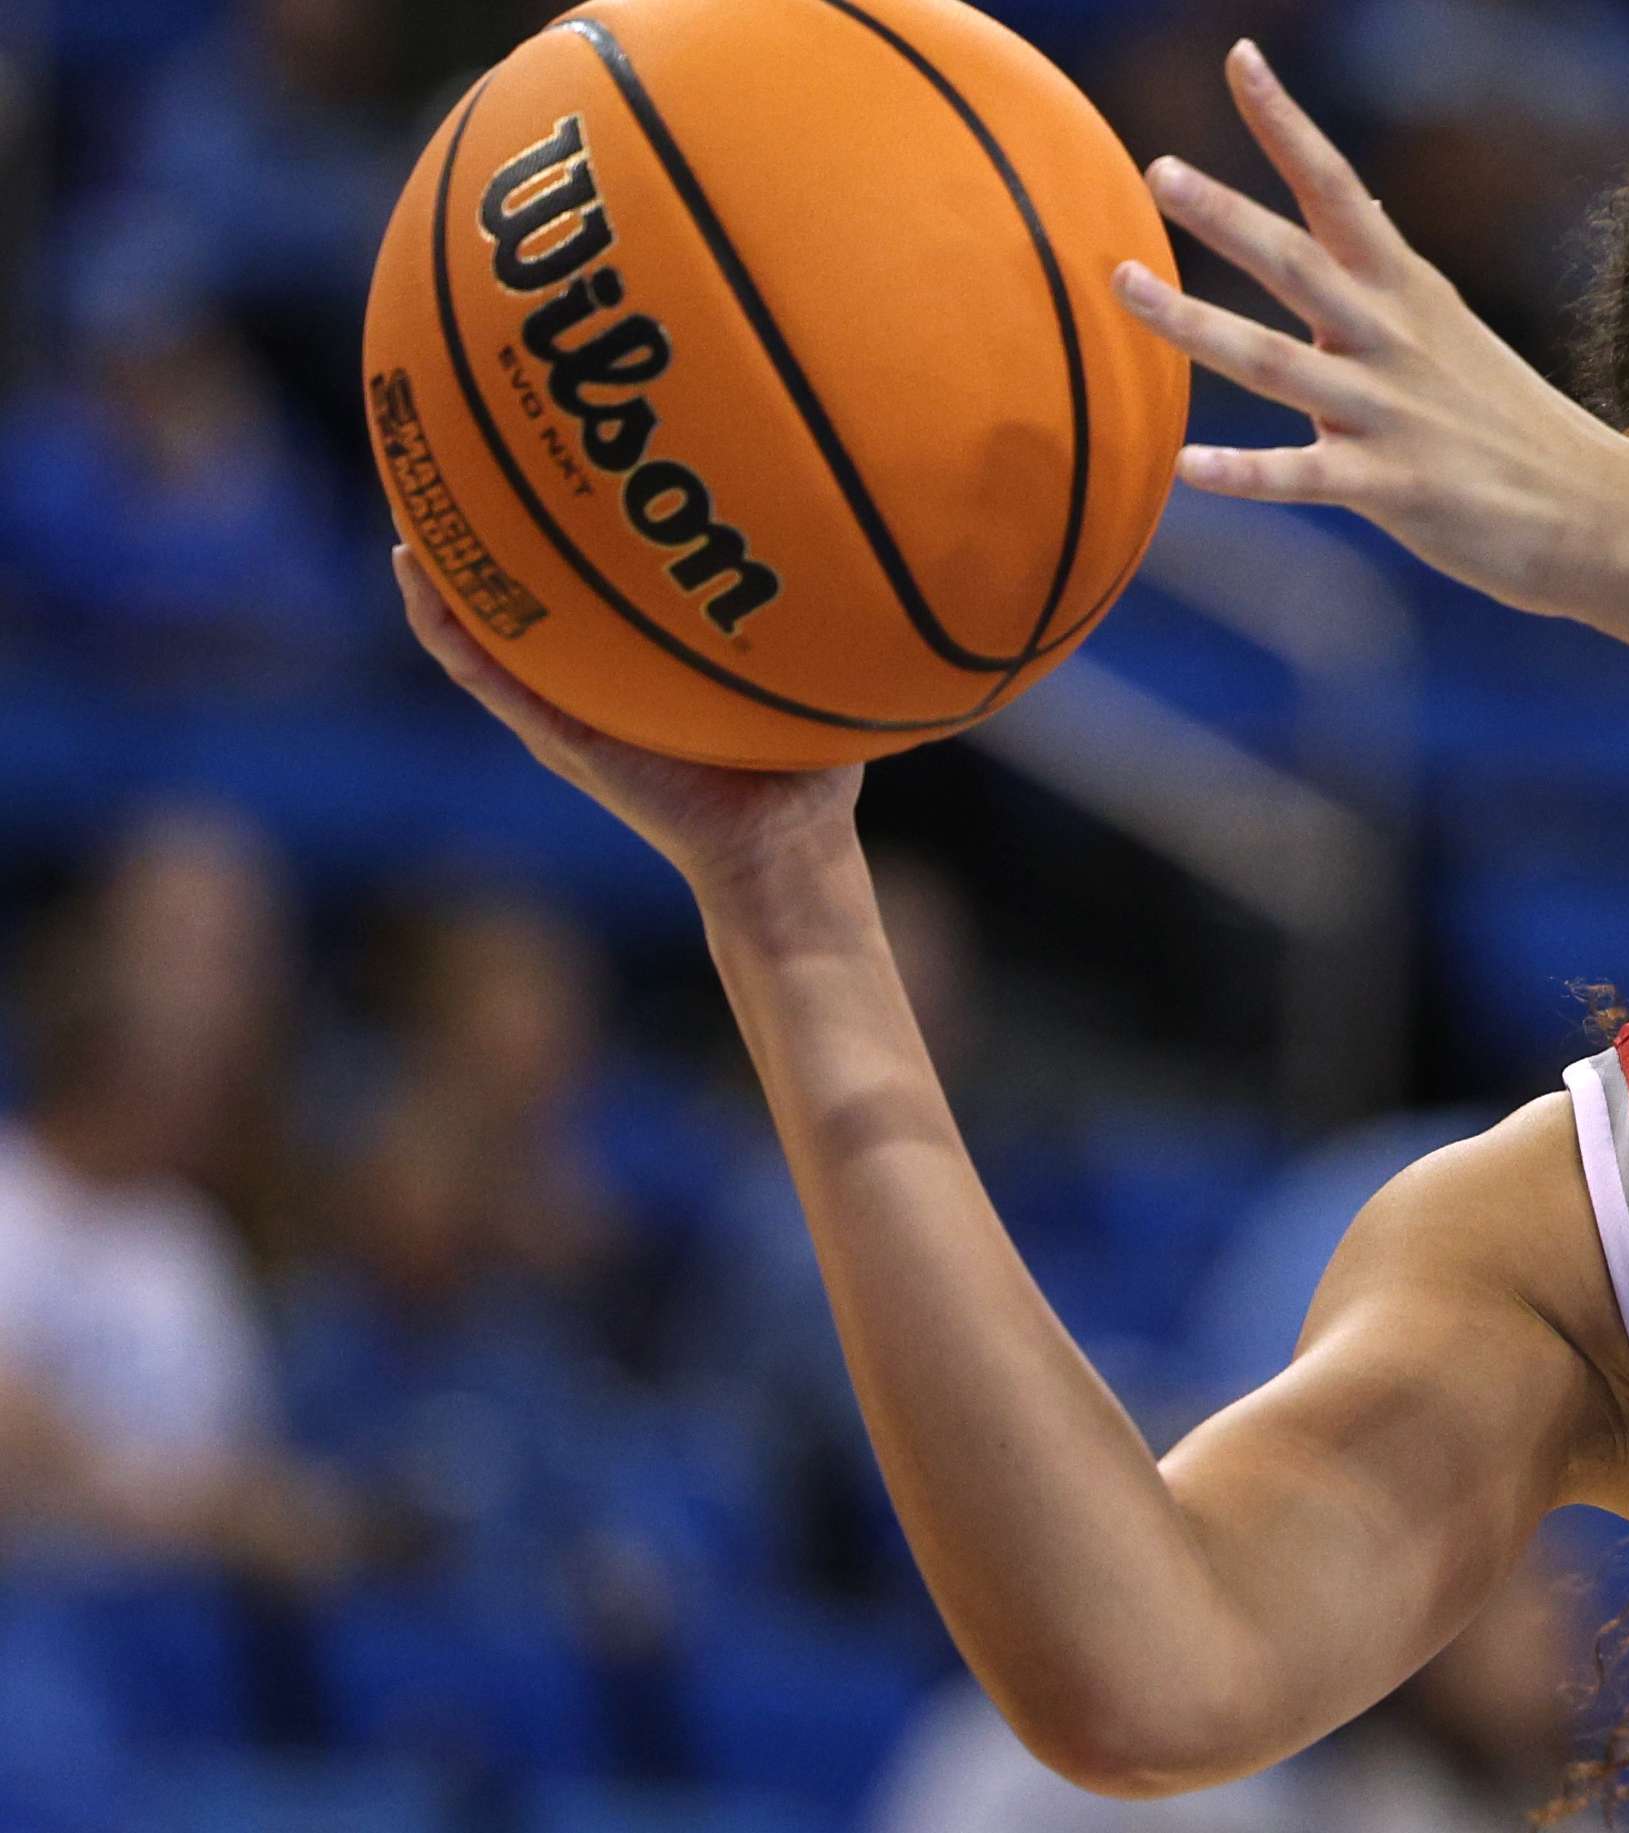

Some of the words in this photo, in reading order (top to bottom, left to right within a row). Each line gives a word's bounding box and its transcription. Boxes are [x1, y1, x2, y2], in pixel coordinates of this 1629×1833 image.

[477, 110, 782, 637] Wilson
[499, 345, 544, 419] EVO
[541, 425, 593, 496] NXT
